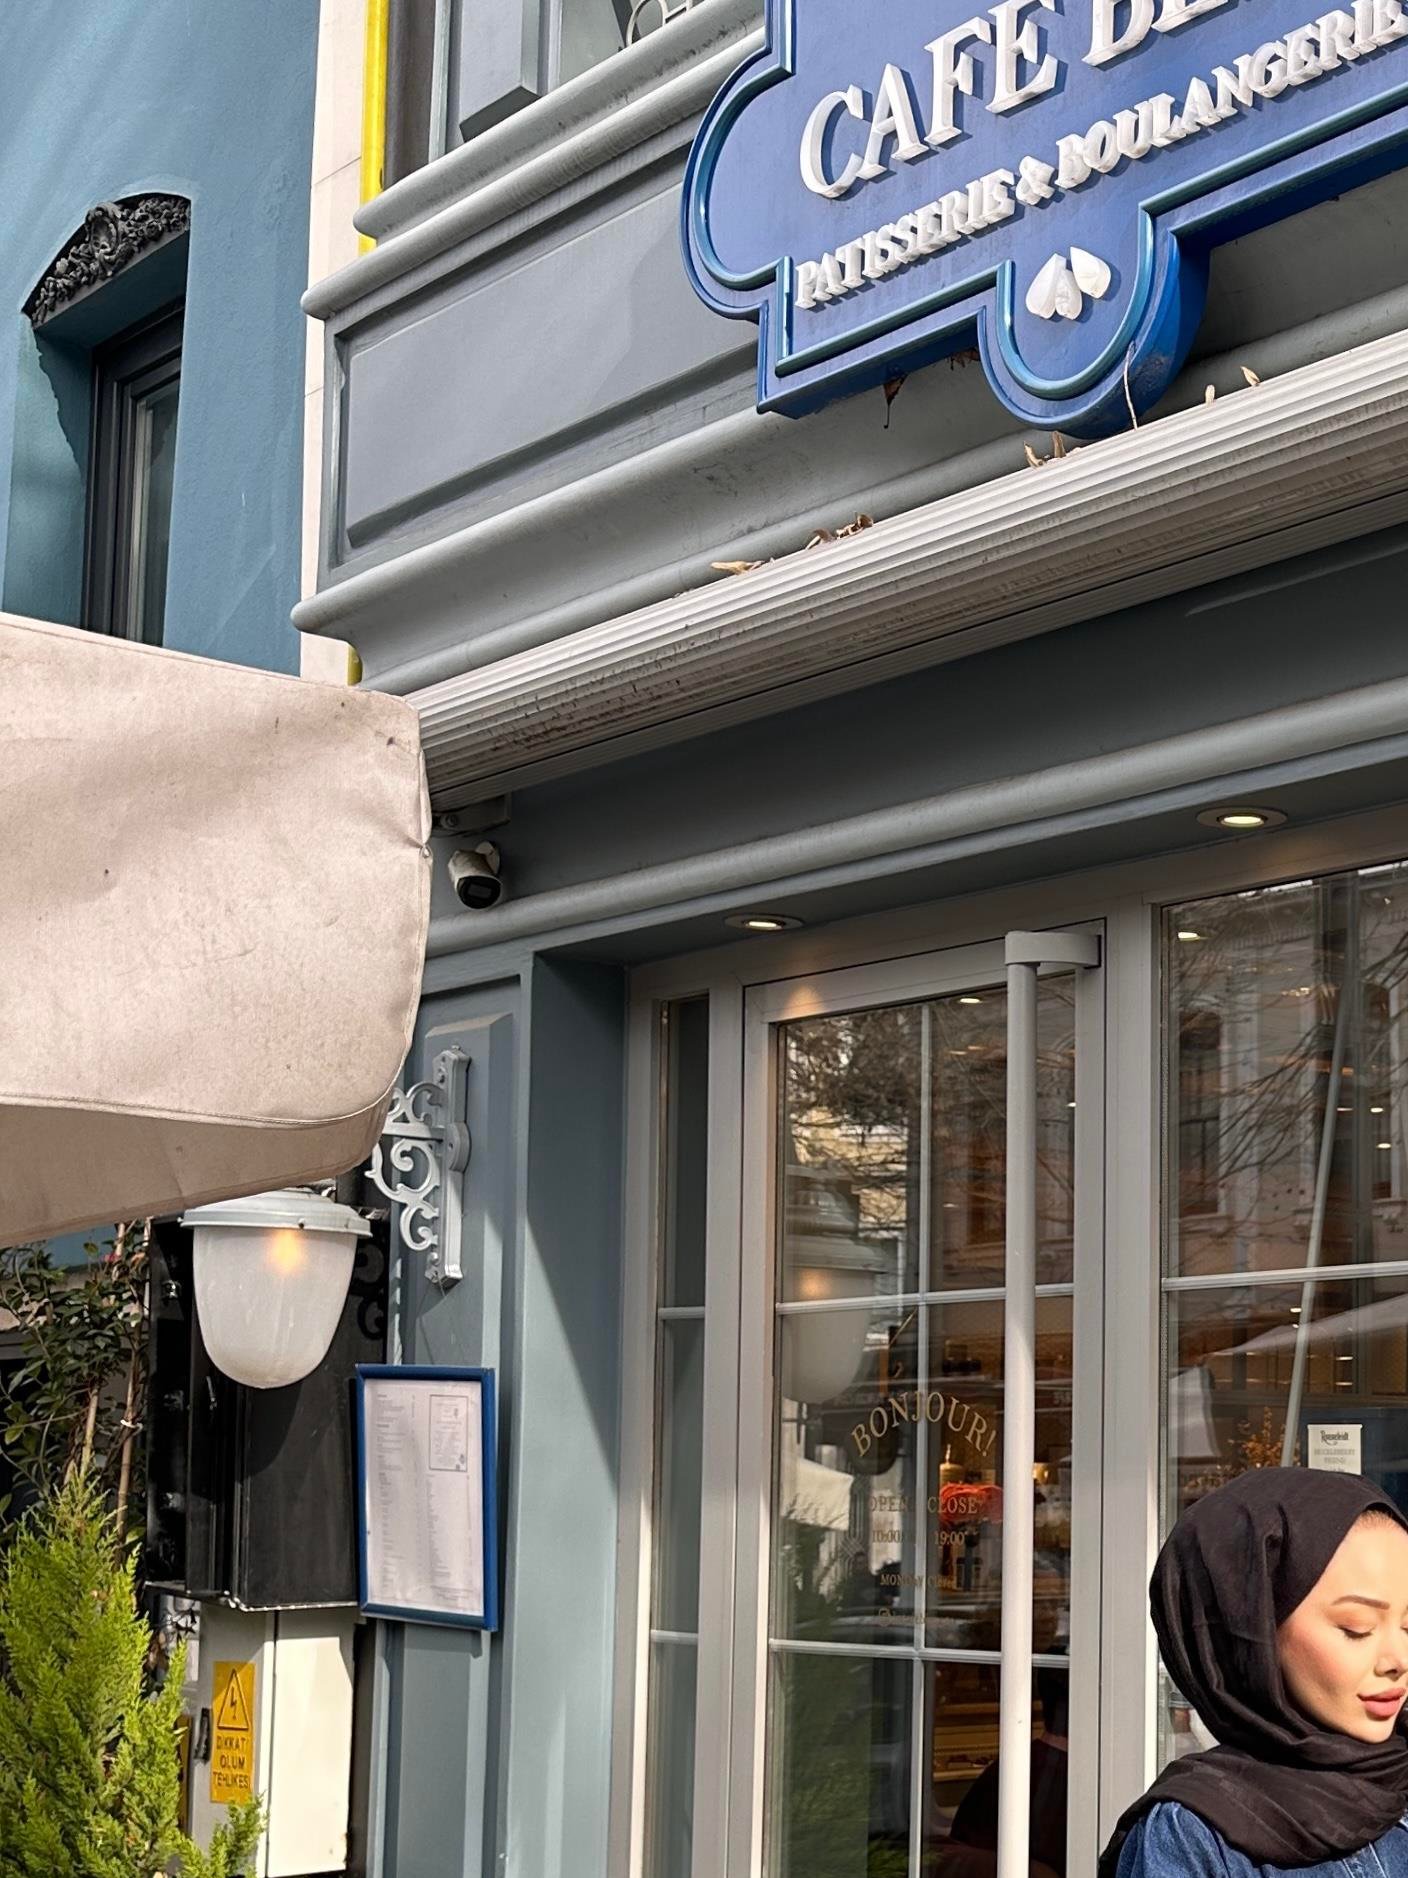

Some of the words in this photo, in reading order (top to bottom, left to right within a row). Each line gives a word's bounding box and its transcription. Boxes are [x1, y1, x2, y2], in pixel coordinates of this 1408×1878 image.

[795, 168, 1016, 309] PATISSERIE
[1015, 155, 1055, 206] &
[851, 1391, 997, 1458] BONJOUR!
[927, 1496, 978, 1514] CLOSE
